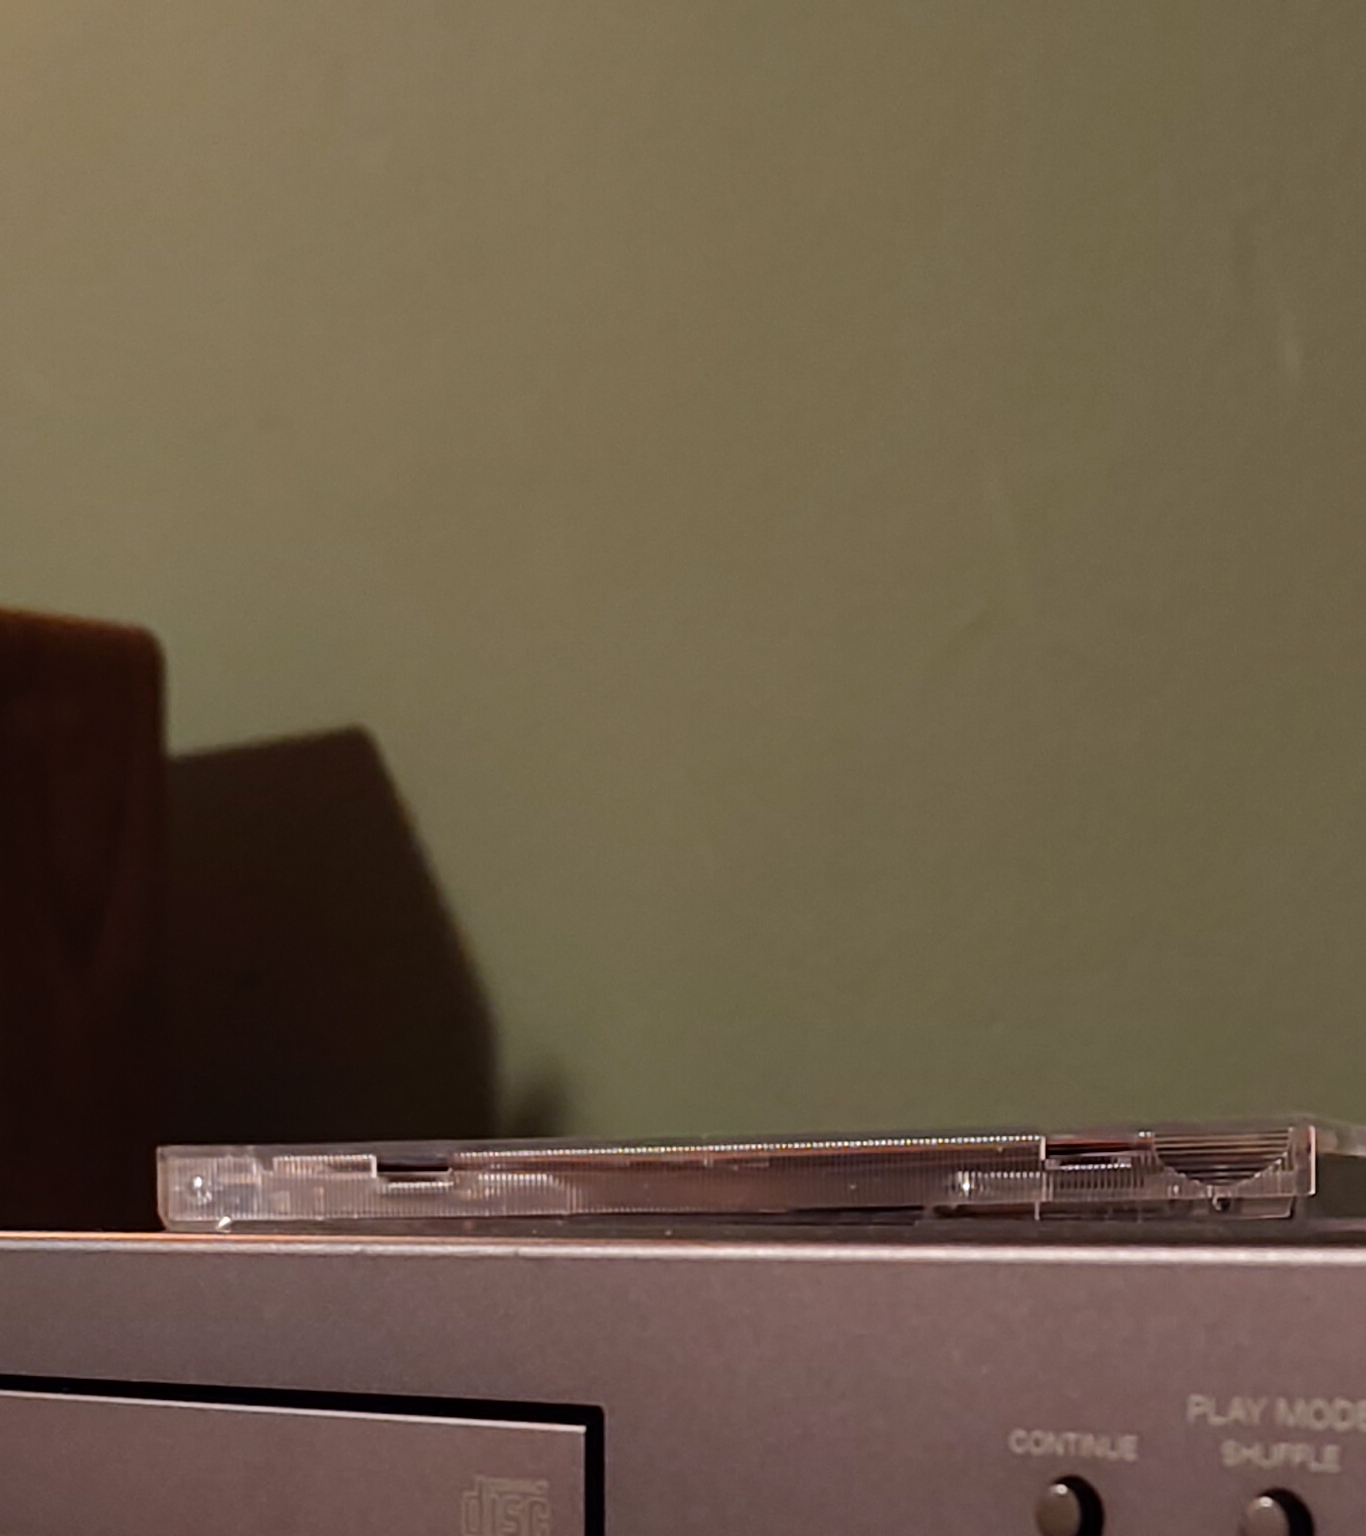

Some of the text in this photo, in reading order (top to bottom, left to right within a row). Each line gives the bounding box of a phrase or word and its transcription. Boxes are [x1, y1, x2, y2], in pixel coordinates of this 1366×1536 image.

[1187, 1393, 1269, 1426] PLAY
[1008, 1428, 1138, 1462] CONTINUE
[1220, 1439, 1341, 1473] SHUFFLE
